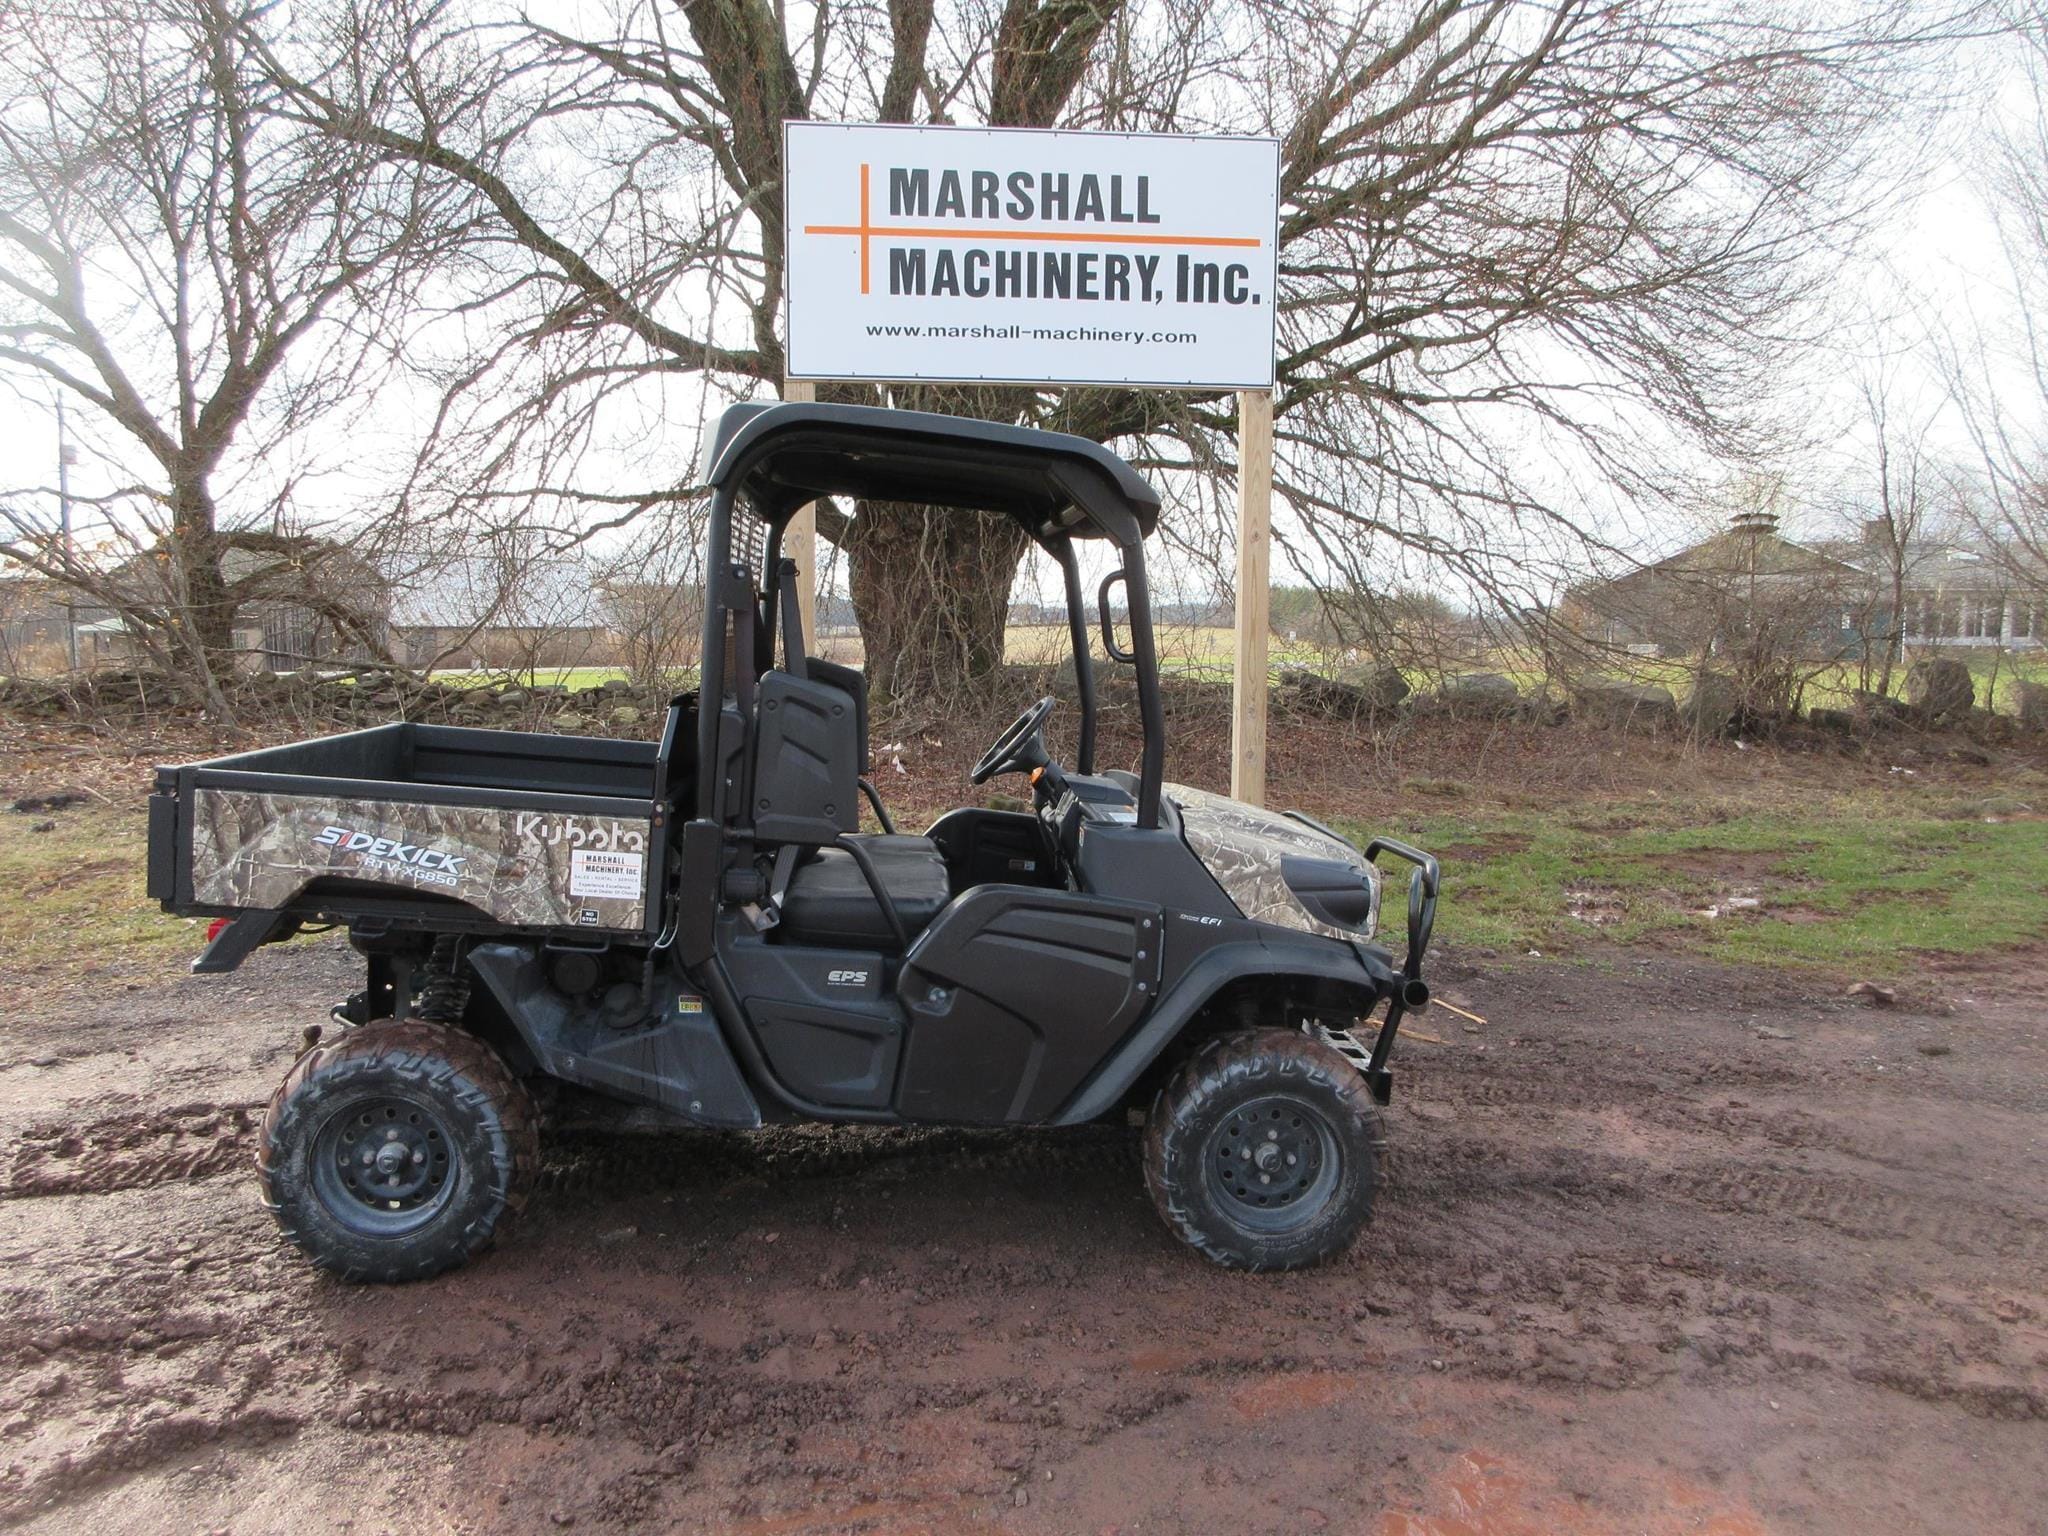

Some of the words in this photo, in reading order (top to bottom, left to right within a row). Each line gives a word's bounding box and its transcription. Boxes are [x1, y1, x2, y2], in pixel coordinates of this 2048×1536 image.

[889, 167, 1161, 224] MARSHALL
[889, 247, 1163, 306] MACHINERY,
[1176, 254, 1261, 305] Inc.
[866, 324, 1198, 344] www.marshall-machinery.com
[516, 815, 643, 851] Kubota
[313, 825, 466, 874] SIDEKICK
[585, 855, 625, 865] MARSHALL
[585, 865, 625, 875] MACHINERY,
[1200, 916, 1222, 926] EFI
[828, 970, 868, 982] EPS
